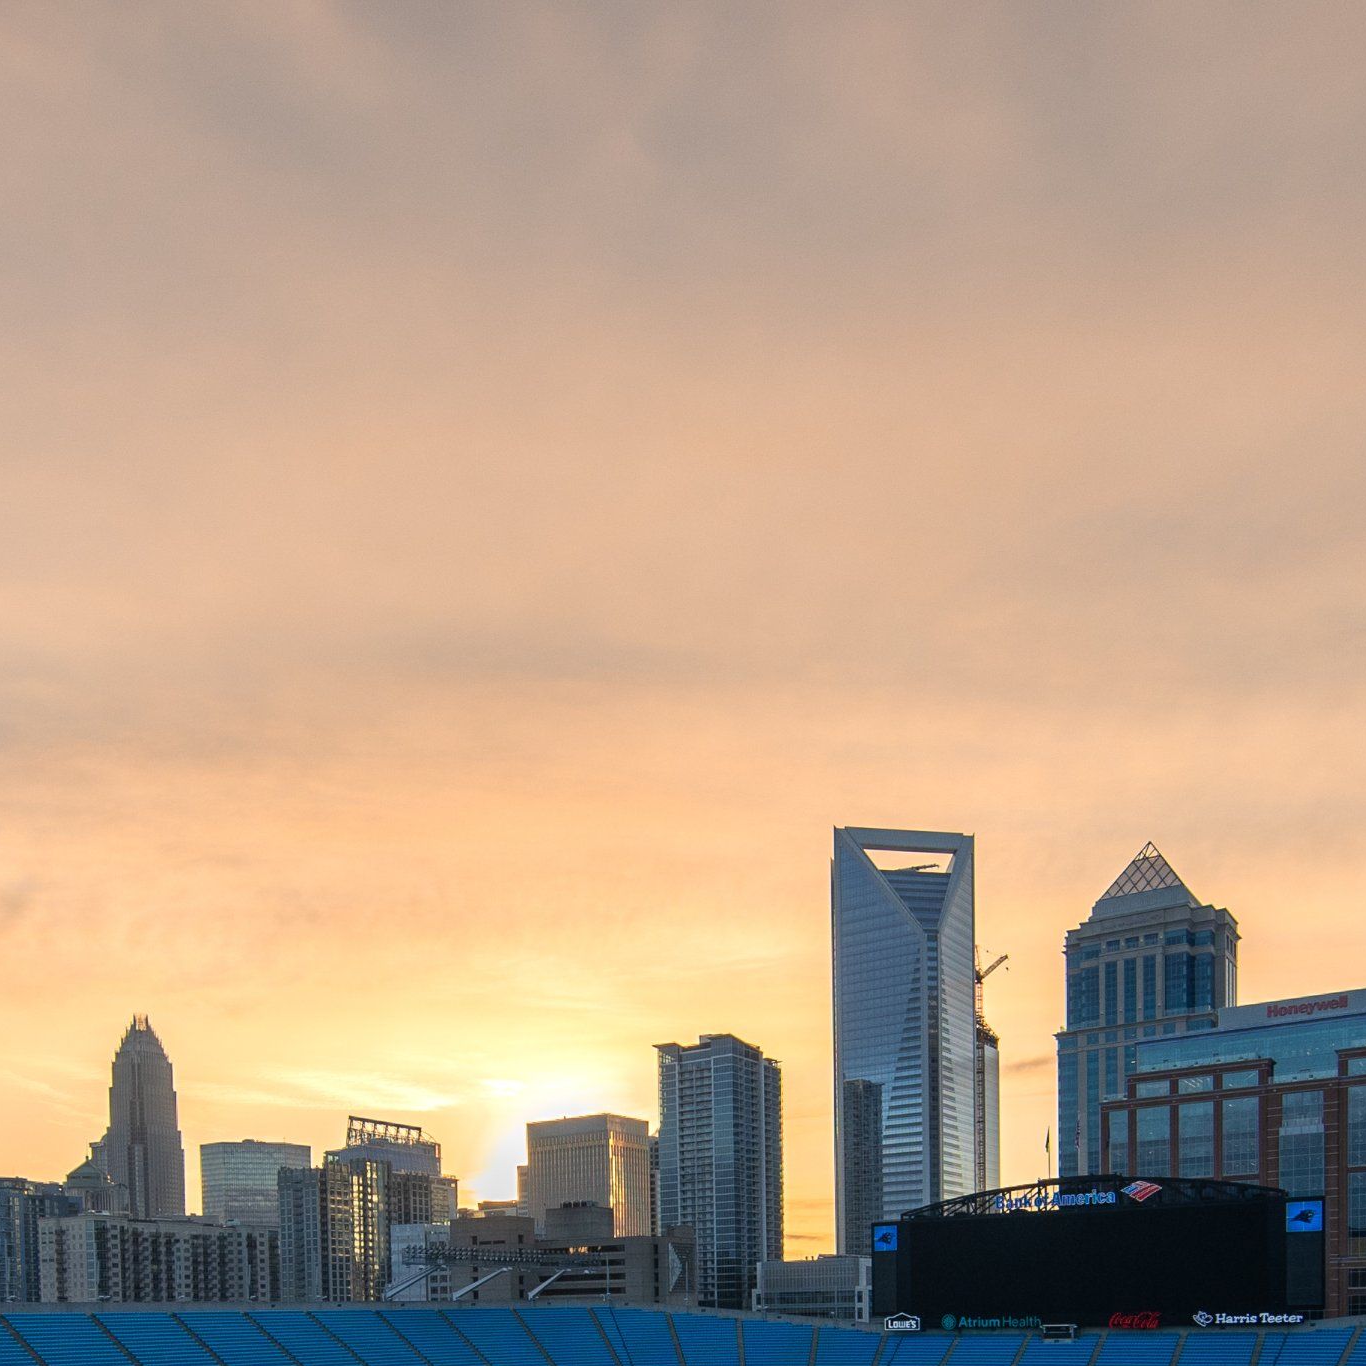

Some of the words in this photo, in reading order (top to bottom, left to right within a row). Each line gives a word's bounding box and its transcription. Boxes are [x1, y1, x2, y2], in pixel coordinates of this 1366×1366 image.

[1266, 995, 1349, 1018] Honeywell
[995, 1195, 1031, 1209] Bank
[1033, 1195, 1048, 1207] of
[1052, 1191, 1116, 1207] America
[887, 1318, 917, 1329] LOWE'S
[958, 1316, 1001, 1328] Atrium
[1002, 1316, 1042, 1328] Health
[1215, 1312, 1257, 1324] Harris
[1259, 1312, 1304, 1324] Teeter
